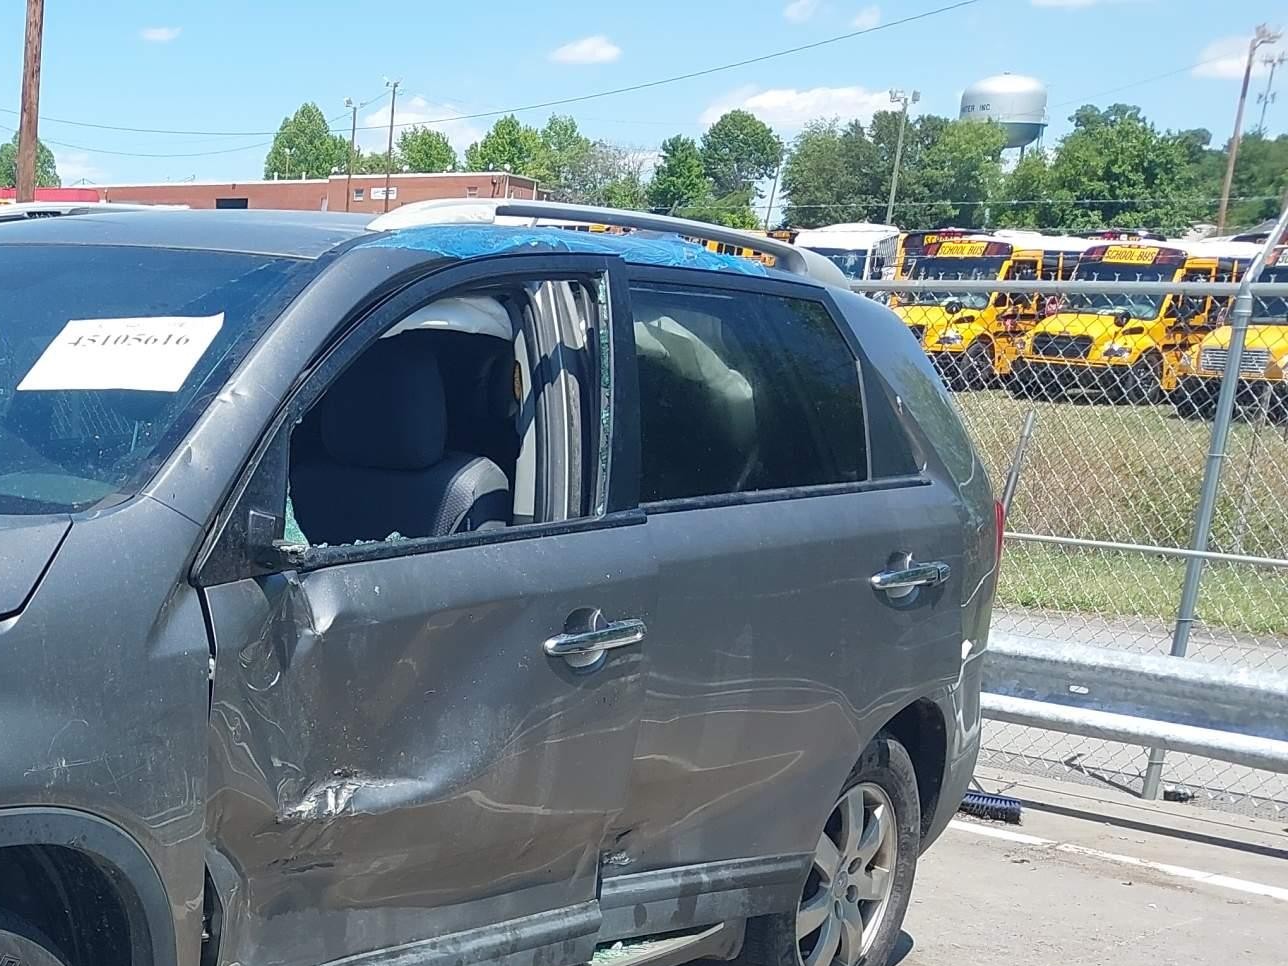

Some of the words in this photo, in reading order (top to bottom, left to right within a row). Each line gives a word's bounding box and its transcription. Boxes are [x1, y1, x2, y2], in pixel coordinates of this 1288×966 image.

[939, 245, 965, 255] SCHOOL
[968, 245, 984, 255] BUS
[1106, 249, 1134, 261] SCHOOL
[1137, 250, 1156, 261] BUS
